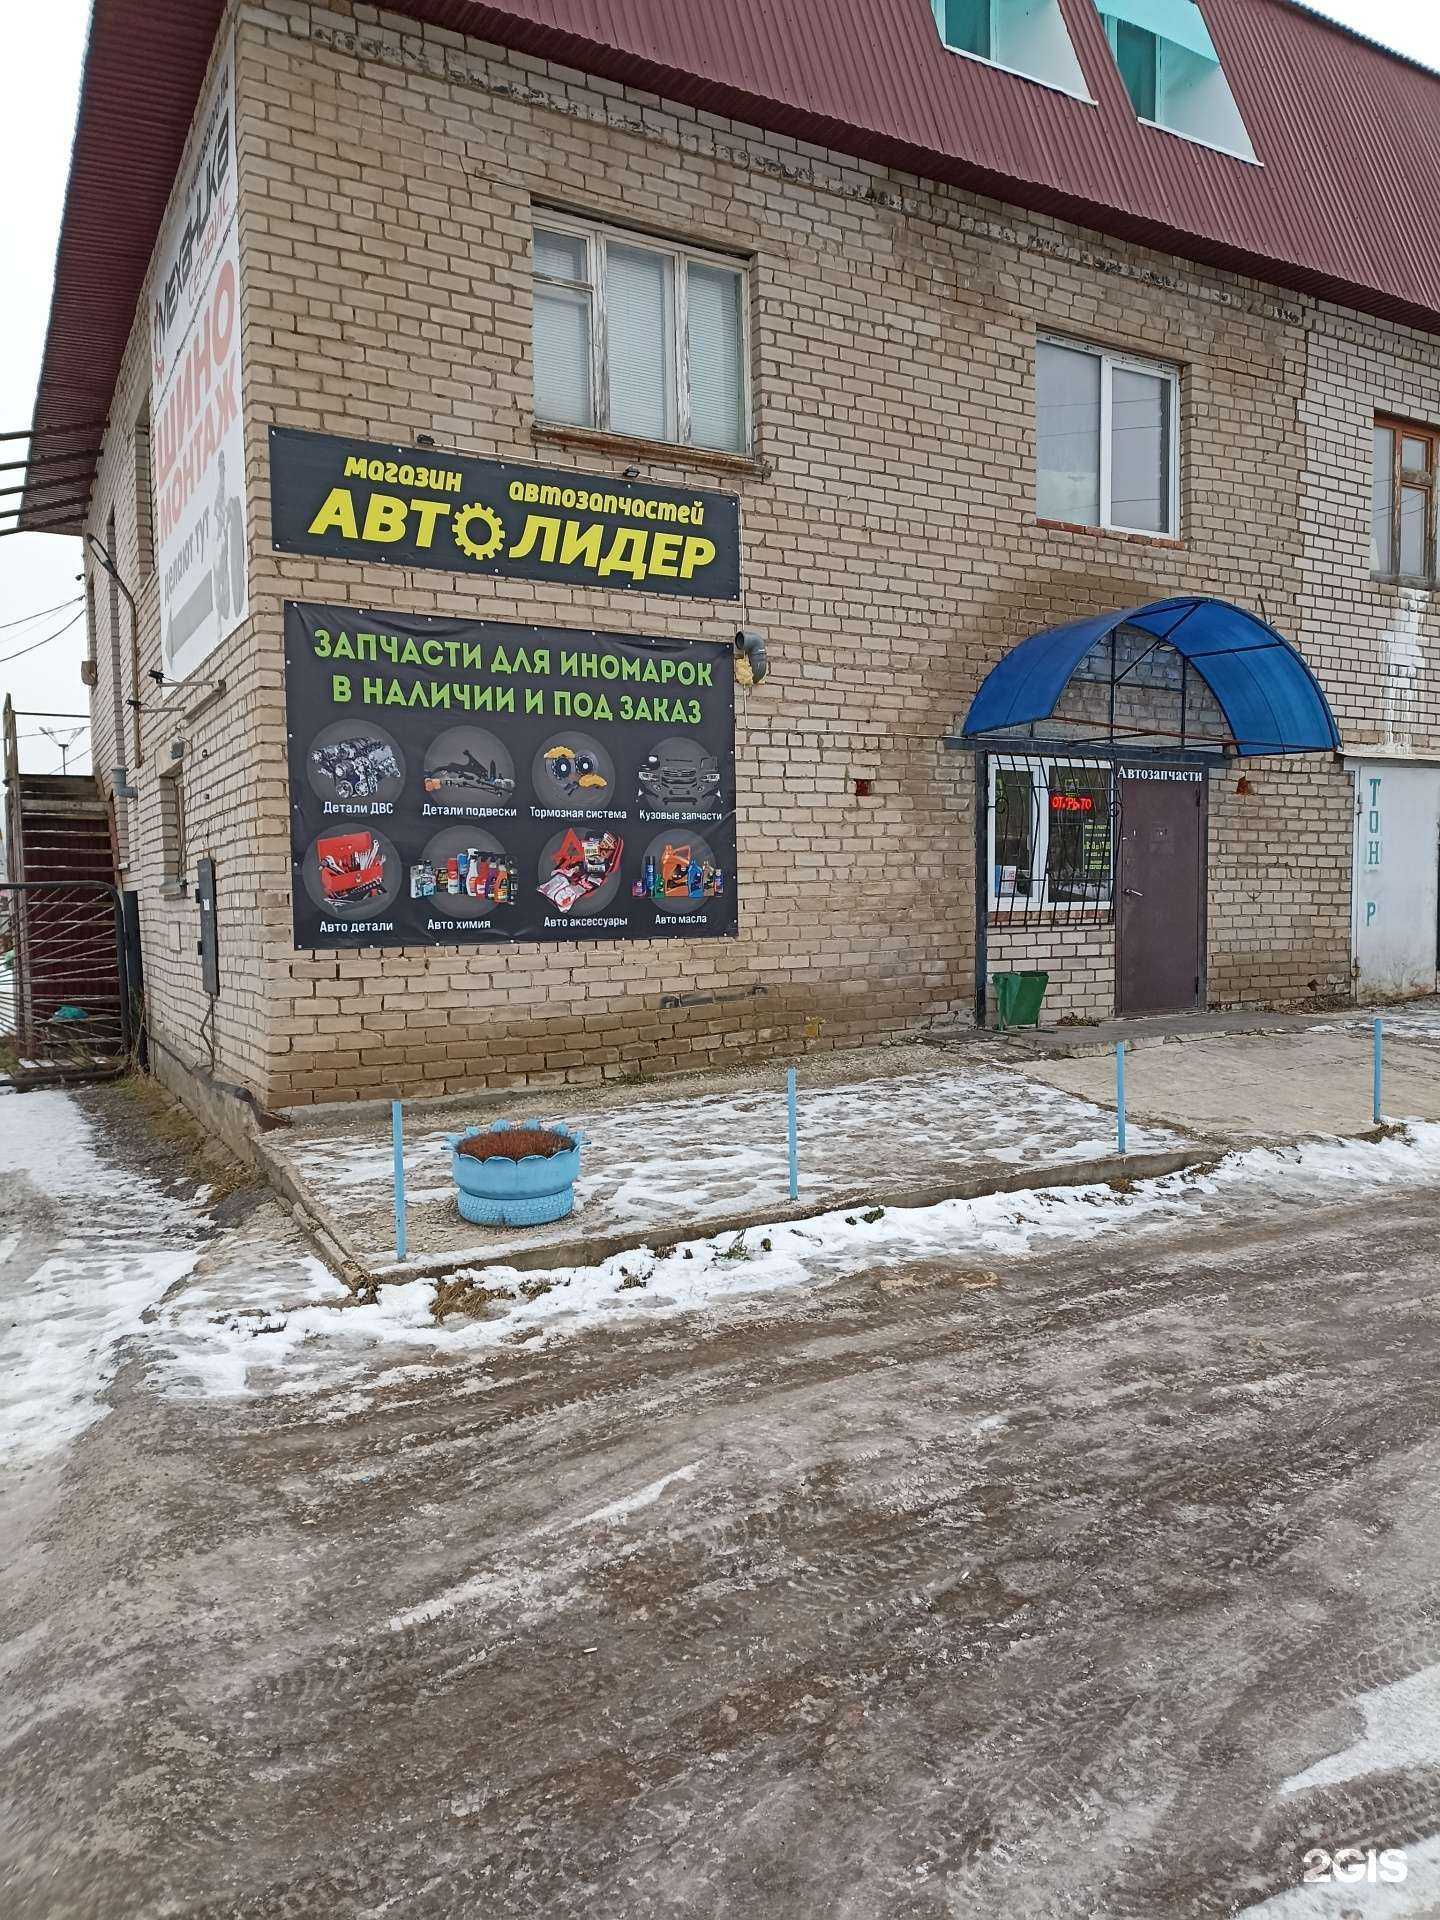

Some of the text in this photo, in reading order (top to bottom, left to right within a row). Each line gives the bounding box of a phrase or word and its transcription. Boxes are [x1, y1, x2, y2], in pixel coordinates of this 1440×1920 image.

[157, 259, 235, 489] ШИНО
[159, 350, 238, 549] МОНТАЖ
[343, 456, 462, 492] магазин
[508, 480, 706, 526] автозапчастей
[314, 629, 713, 687] ЗАПЧАСТИ ДЛЯ ИНОМАРОК
[332, 675, 702, 724] В НАЛИЧИИ И ПОД ЗАКАЗ
[1117, 764, 1203, 782] Автозапчасти
[323, 801, 394, 814] Детали ДВС
[422, 803, 517, 818] Детали подвески
[530, 806, 627, 819] Тормозная система
[639, 809, 722, 821] Кузовые запчасти
[320, 920, 393, 934] Авто детали
[427, 918, 491, 931] Авто химия
[544, 916, 628, 928] Авто аксессуары
[655, 914, 708, 925] Авто масла
